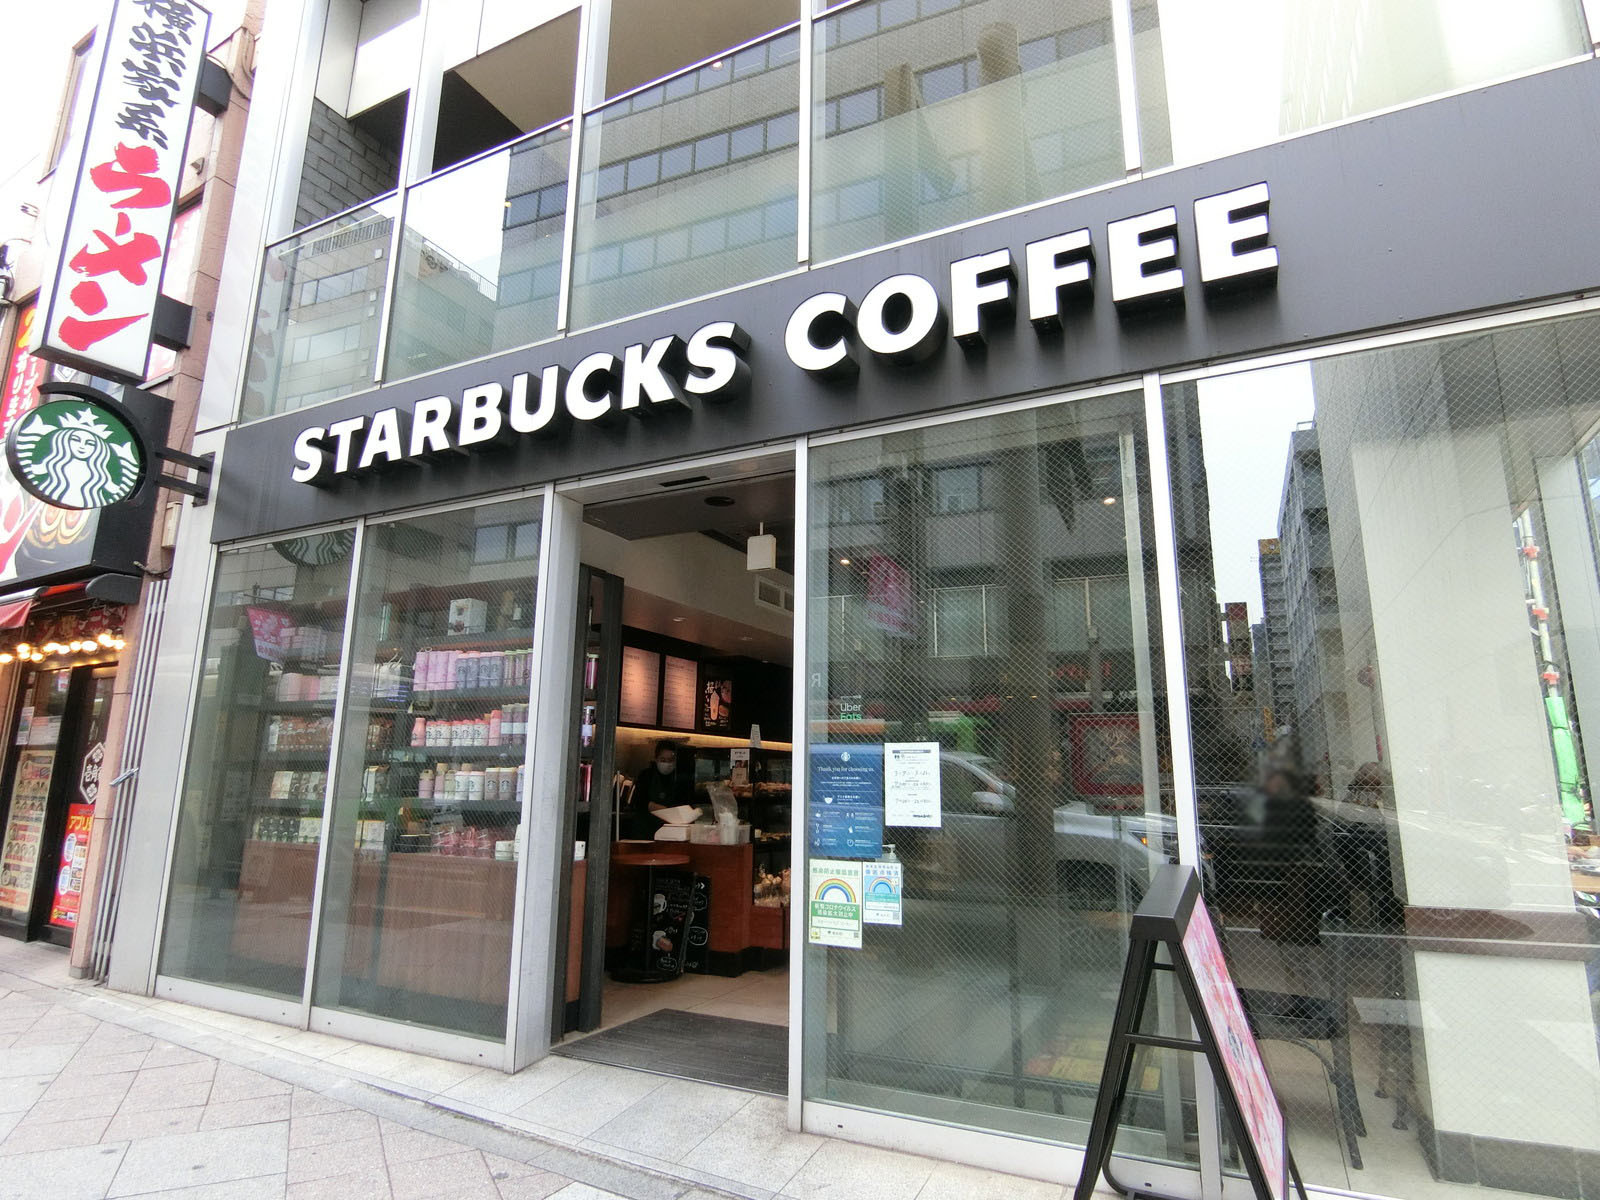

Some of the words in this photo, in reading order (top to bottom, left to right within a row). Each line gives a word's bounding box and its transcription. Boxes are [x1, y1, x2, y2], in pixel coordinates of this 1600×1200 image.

[291, 321, 745, 484] STARBUCKS
[784, 181, 1279, 372] COFFEE
[840, 702, 861, 711] Uber
[840, 712, 862, 721] Eats
